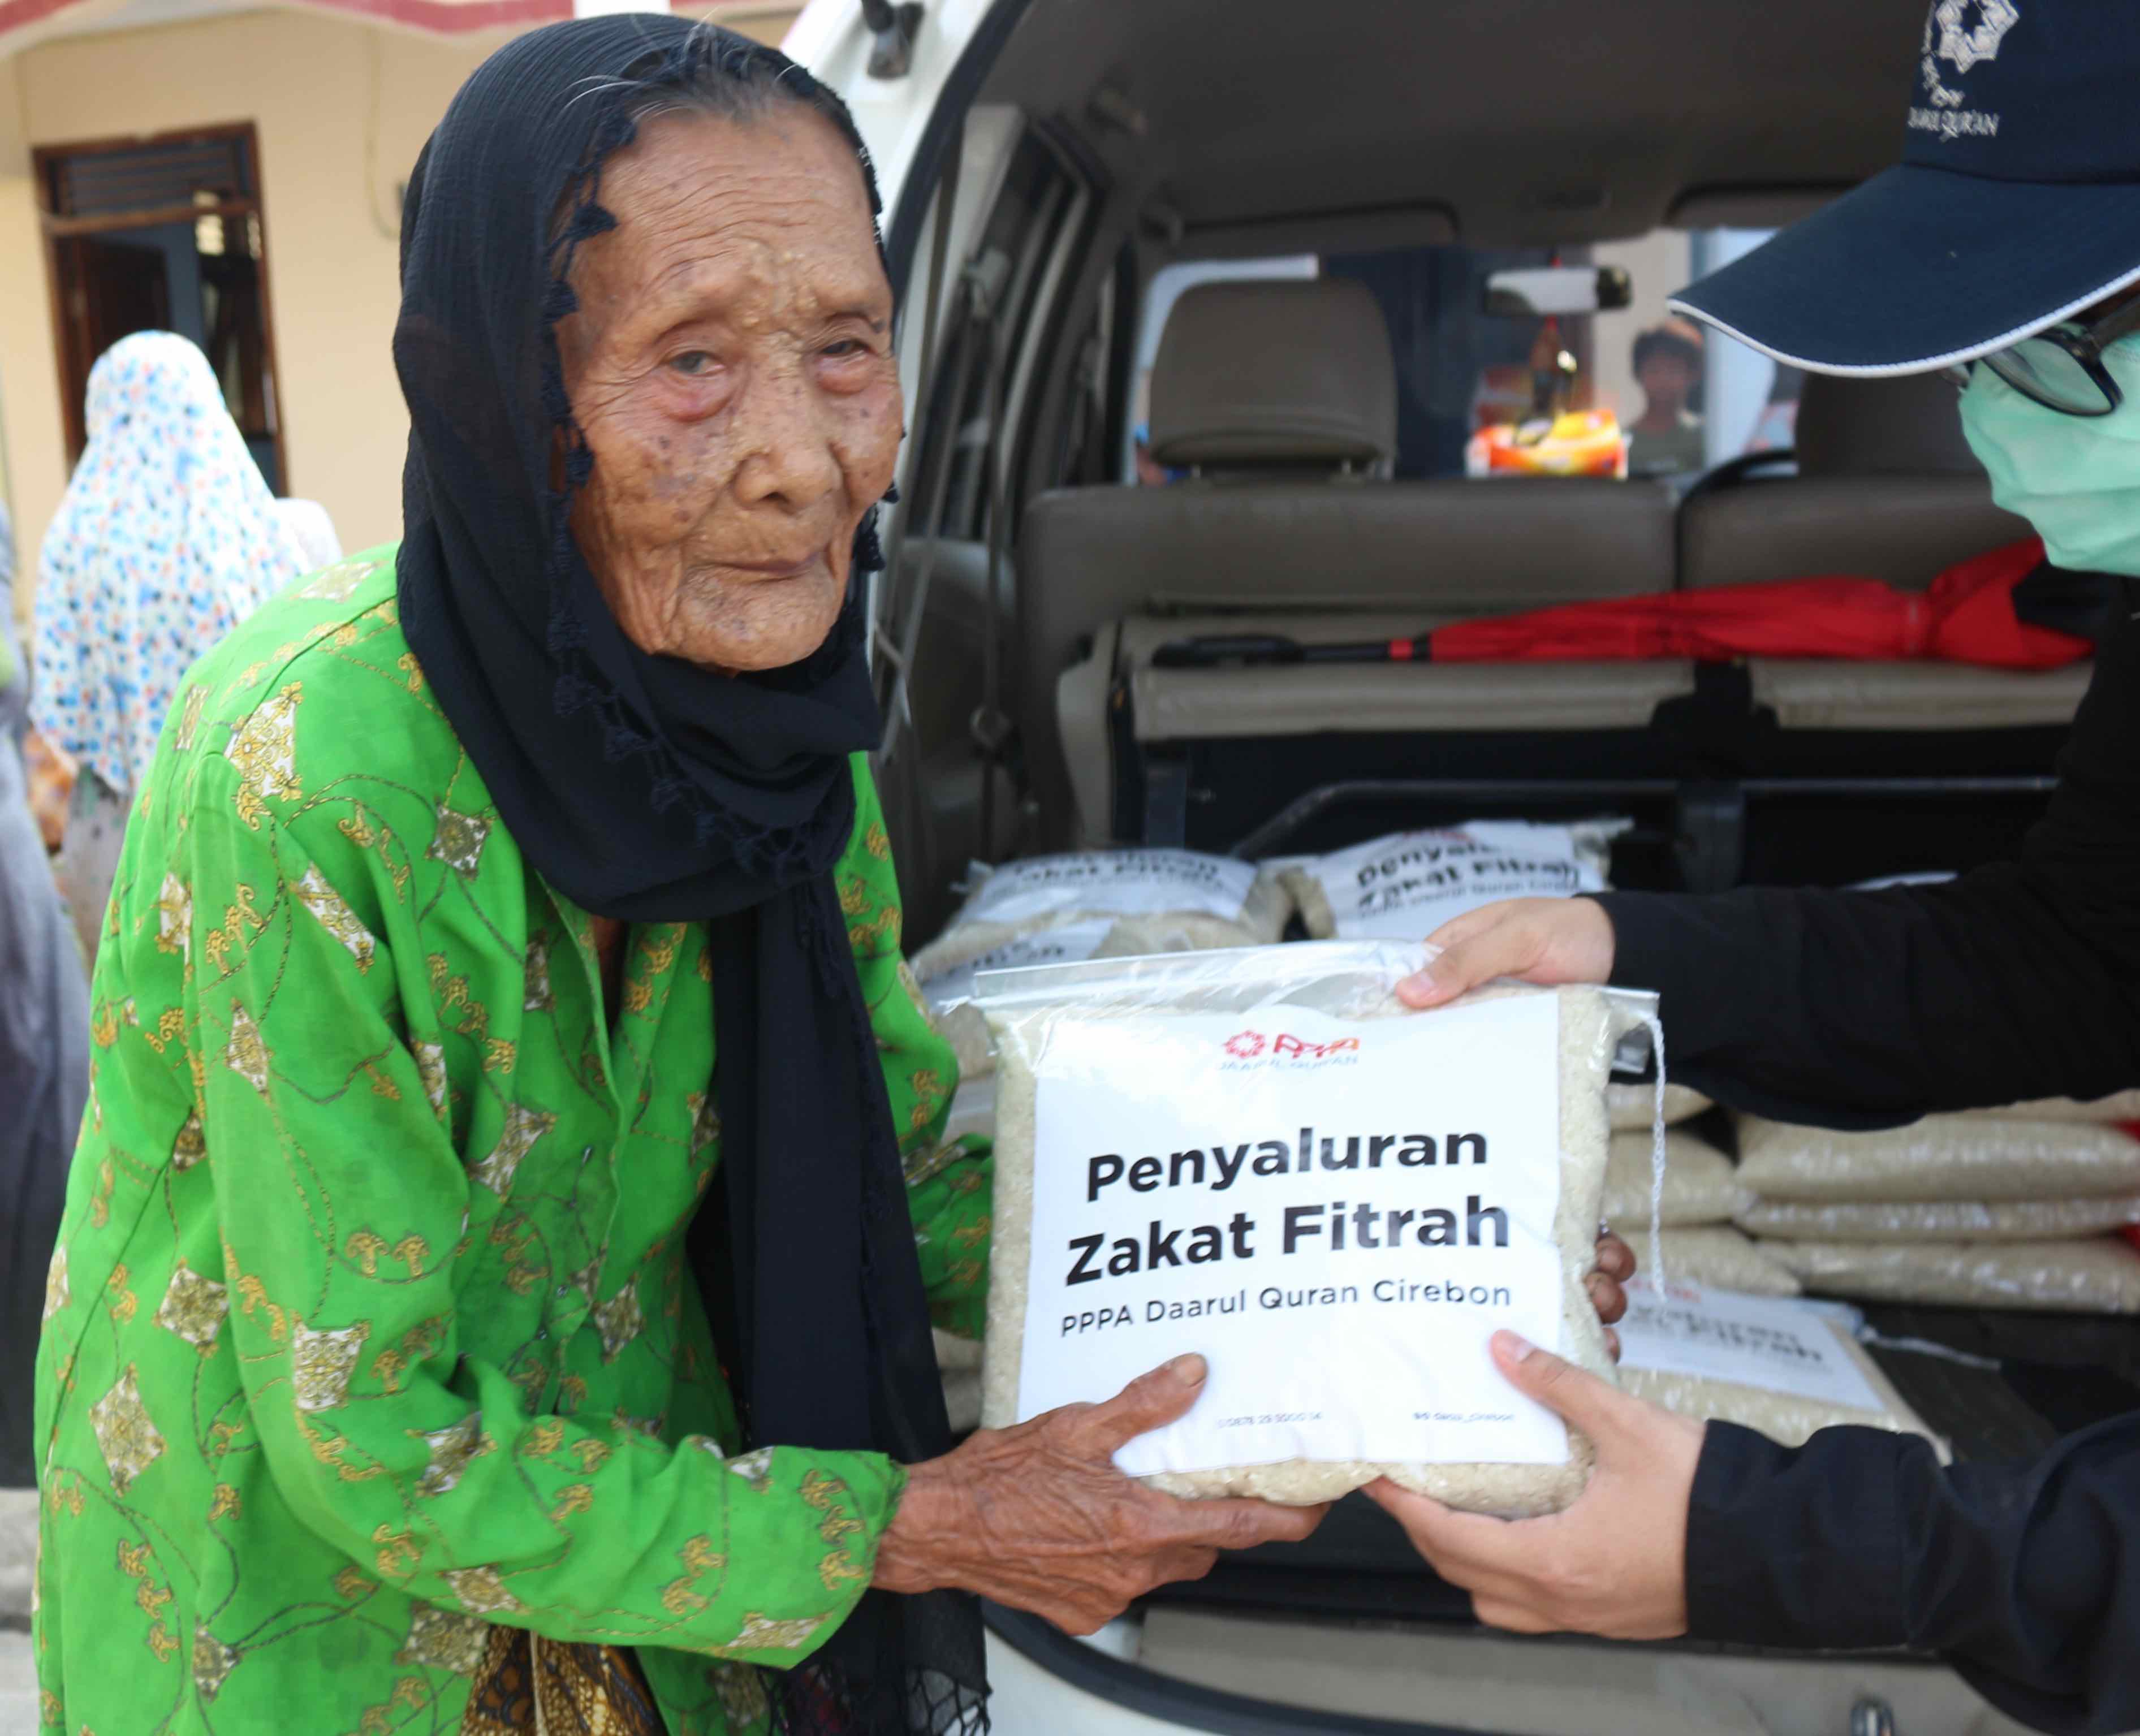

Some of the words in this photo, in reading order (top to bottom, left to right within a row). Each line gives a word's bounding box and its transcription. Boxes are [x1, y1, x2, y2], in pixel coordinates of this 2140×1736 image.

[1087, 1127, 1488, 1203] Penyaluran
[1065, 1212, 1256, 1287] Zakat
[1283, 1195, 1509, 1255] Fitrah
[1061, 1304, 1134, 1338] PPPA
[1146, 1289, 1245, 1323] Daarul
[1259, 1286, 1358, 1311] Quran
[1373, 1279, 1511, 1306] Cirebon
